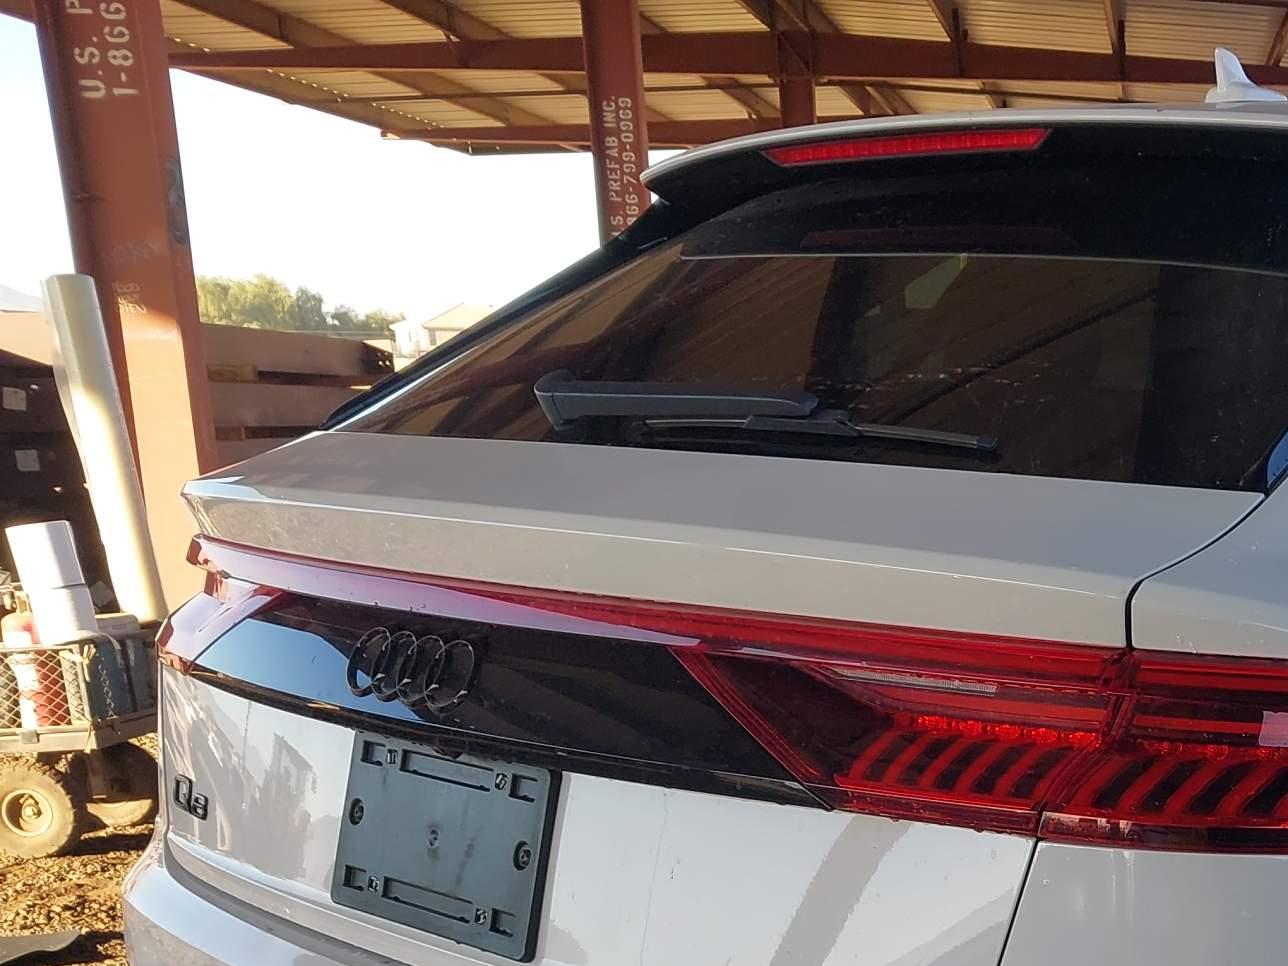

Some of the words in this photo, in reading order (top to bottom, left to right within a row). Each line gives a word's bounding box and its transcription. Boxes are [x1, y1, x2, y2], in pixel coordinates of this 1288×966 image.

[74, 36, 105, 98] U.S.
[602, 96, 616, 128] INC.
[605, 136, 622, 200] PREFAB
[174, 774, 208, 821] Q8
